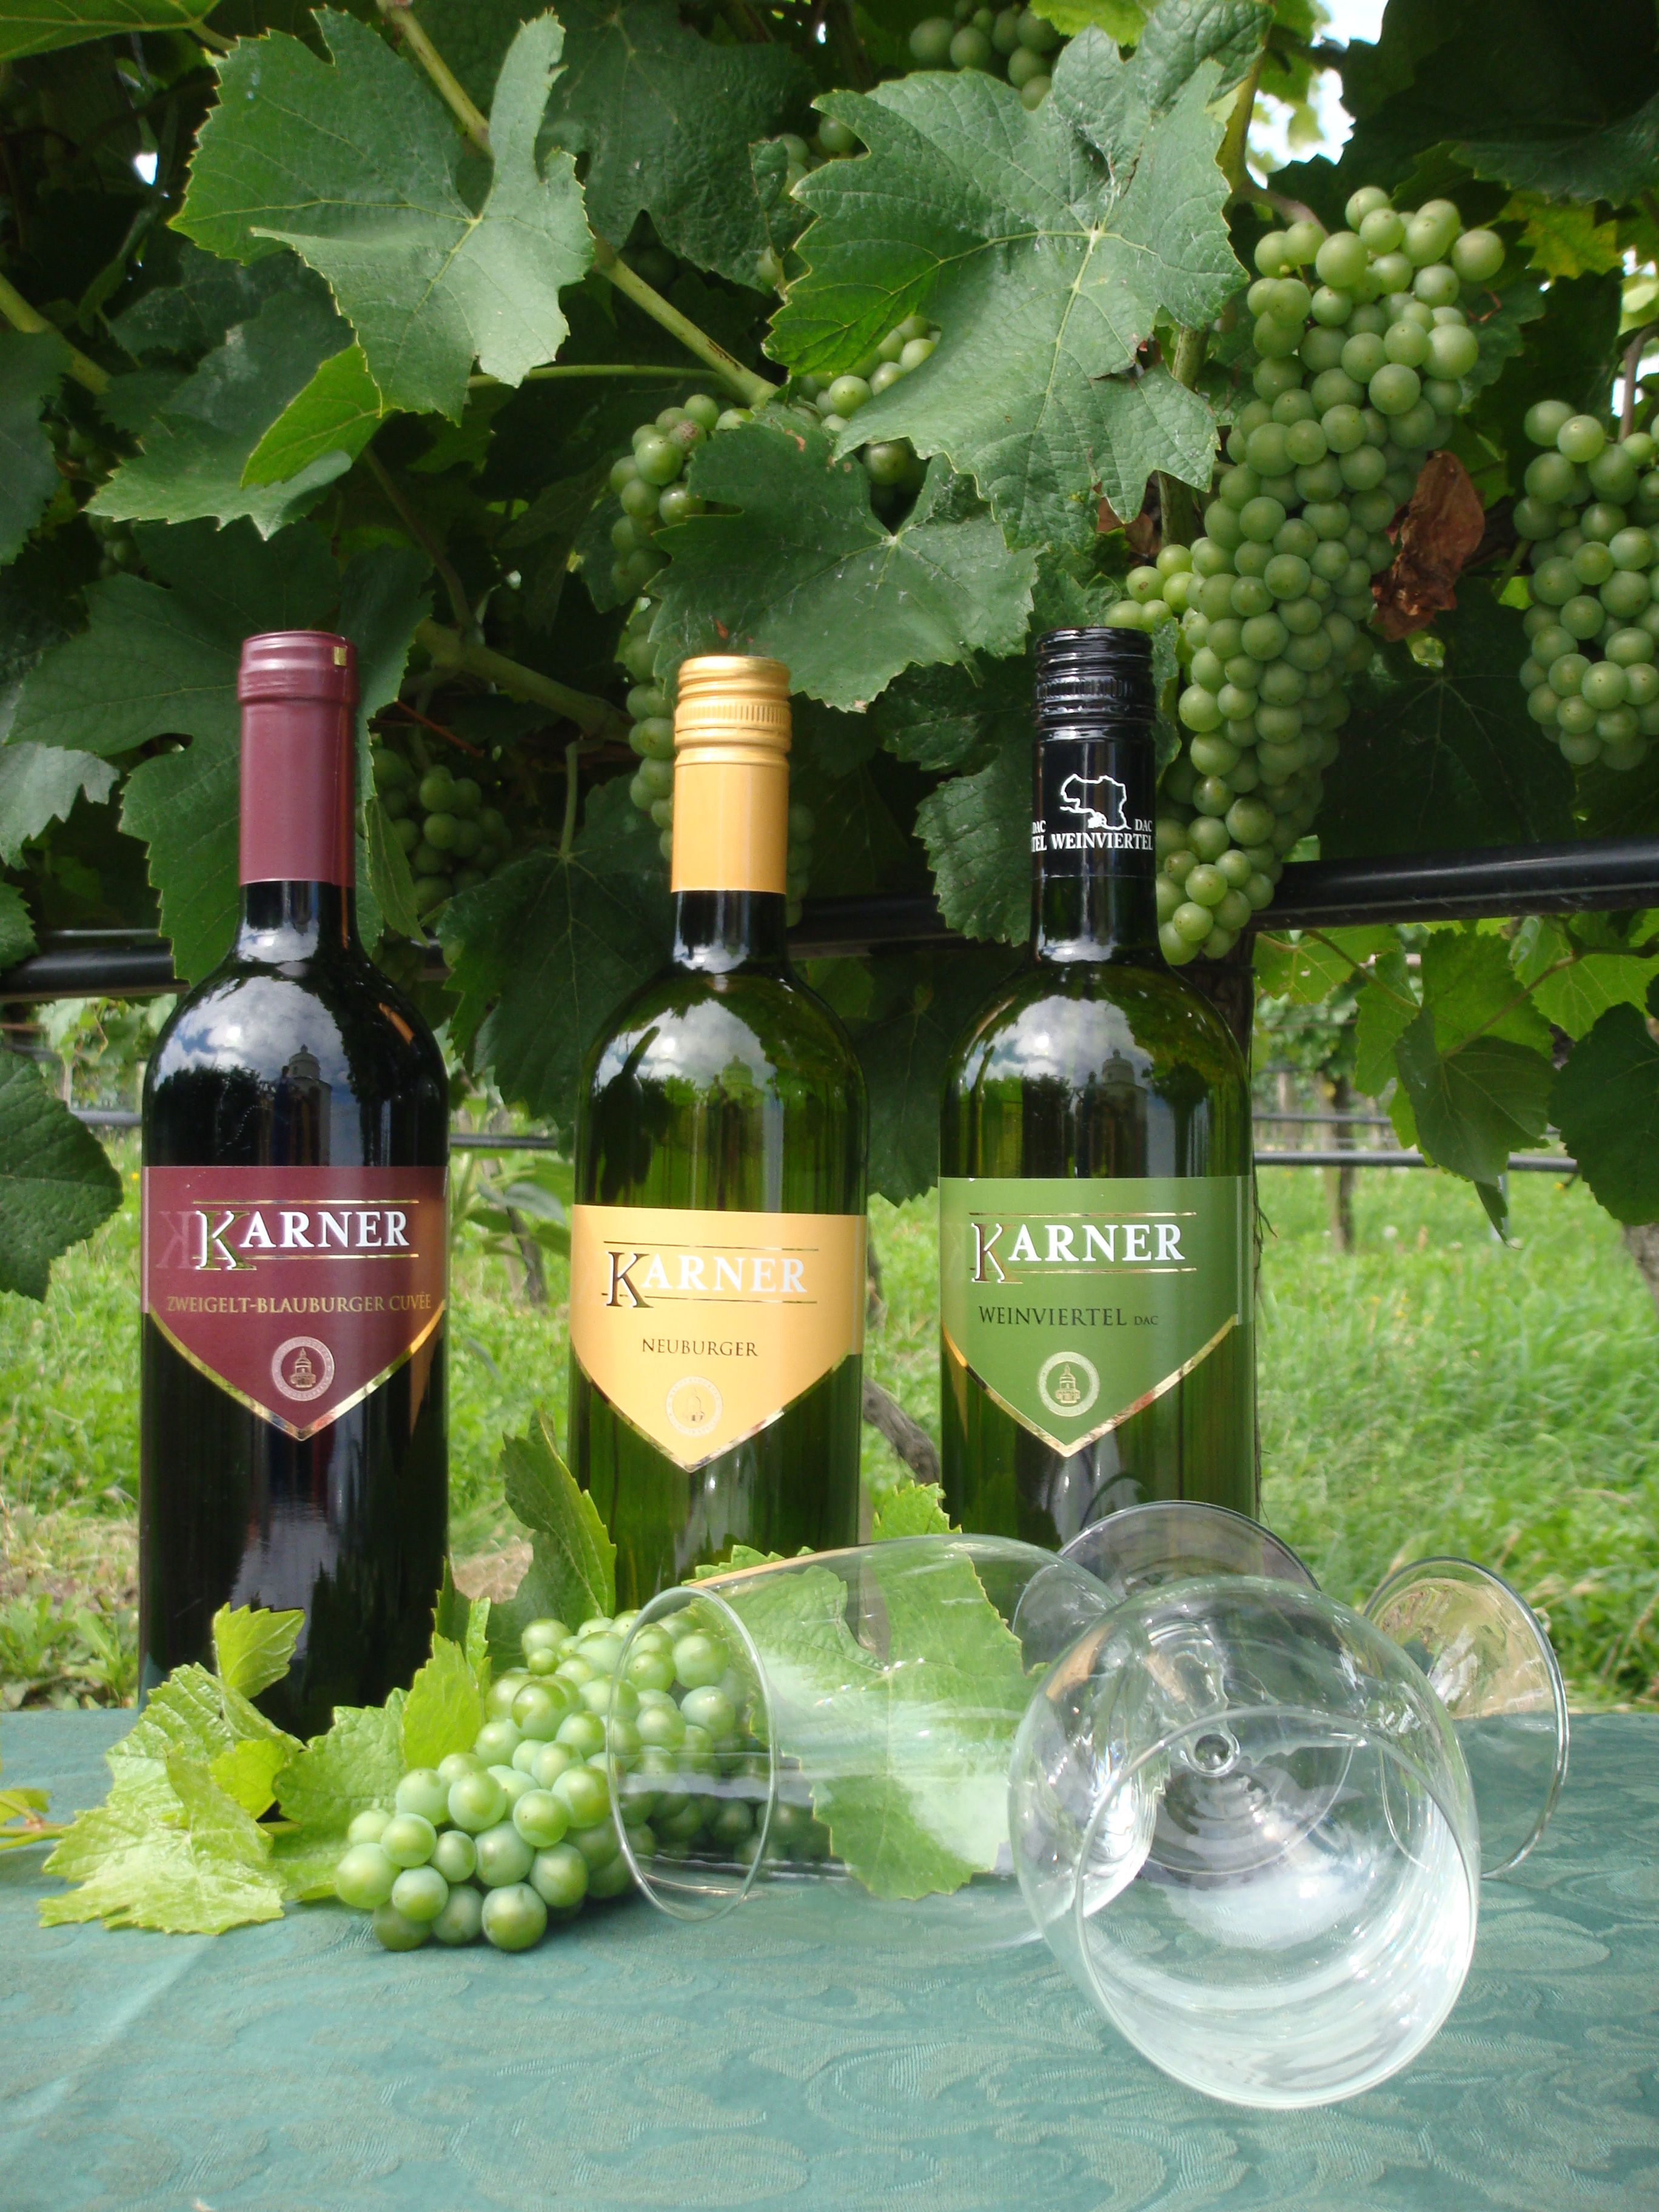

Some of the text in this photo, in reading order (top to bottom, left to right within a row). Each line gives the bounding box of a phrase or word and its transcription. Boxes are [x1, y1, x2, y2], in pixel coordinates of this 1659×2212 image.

[1134, 819, 1153, 832] DAC
[1051, 833, 1153, 851] WEINVIERTEL
[195, 1210, 411, 1271] KARNER
[970, 1222, 1185, 1284] KARNER
[605, 1251, 808, 1309] KARNER
[166, 1295, 385, 1314] ZWEIGELT-BLAUBURGER
[978, 1305, 1159, 1326] WEINVIERTEL DAC
[642, 1338, 759, 1357] NEUBURGER
